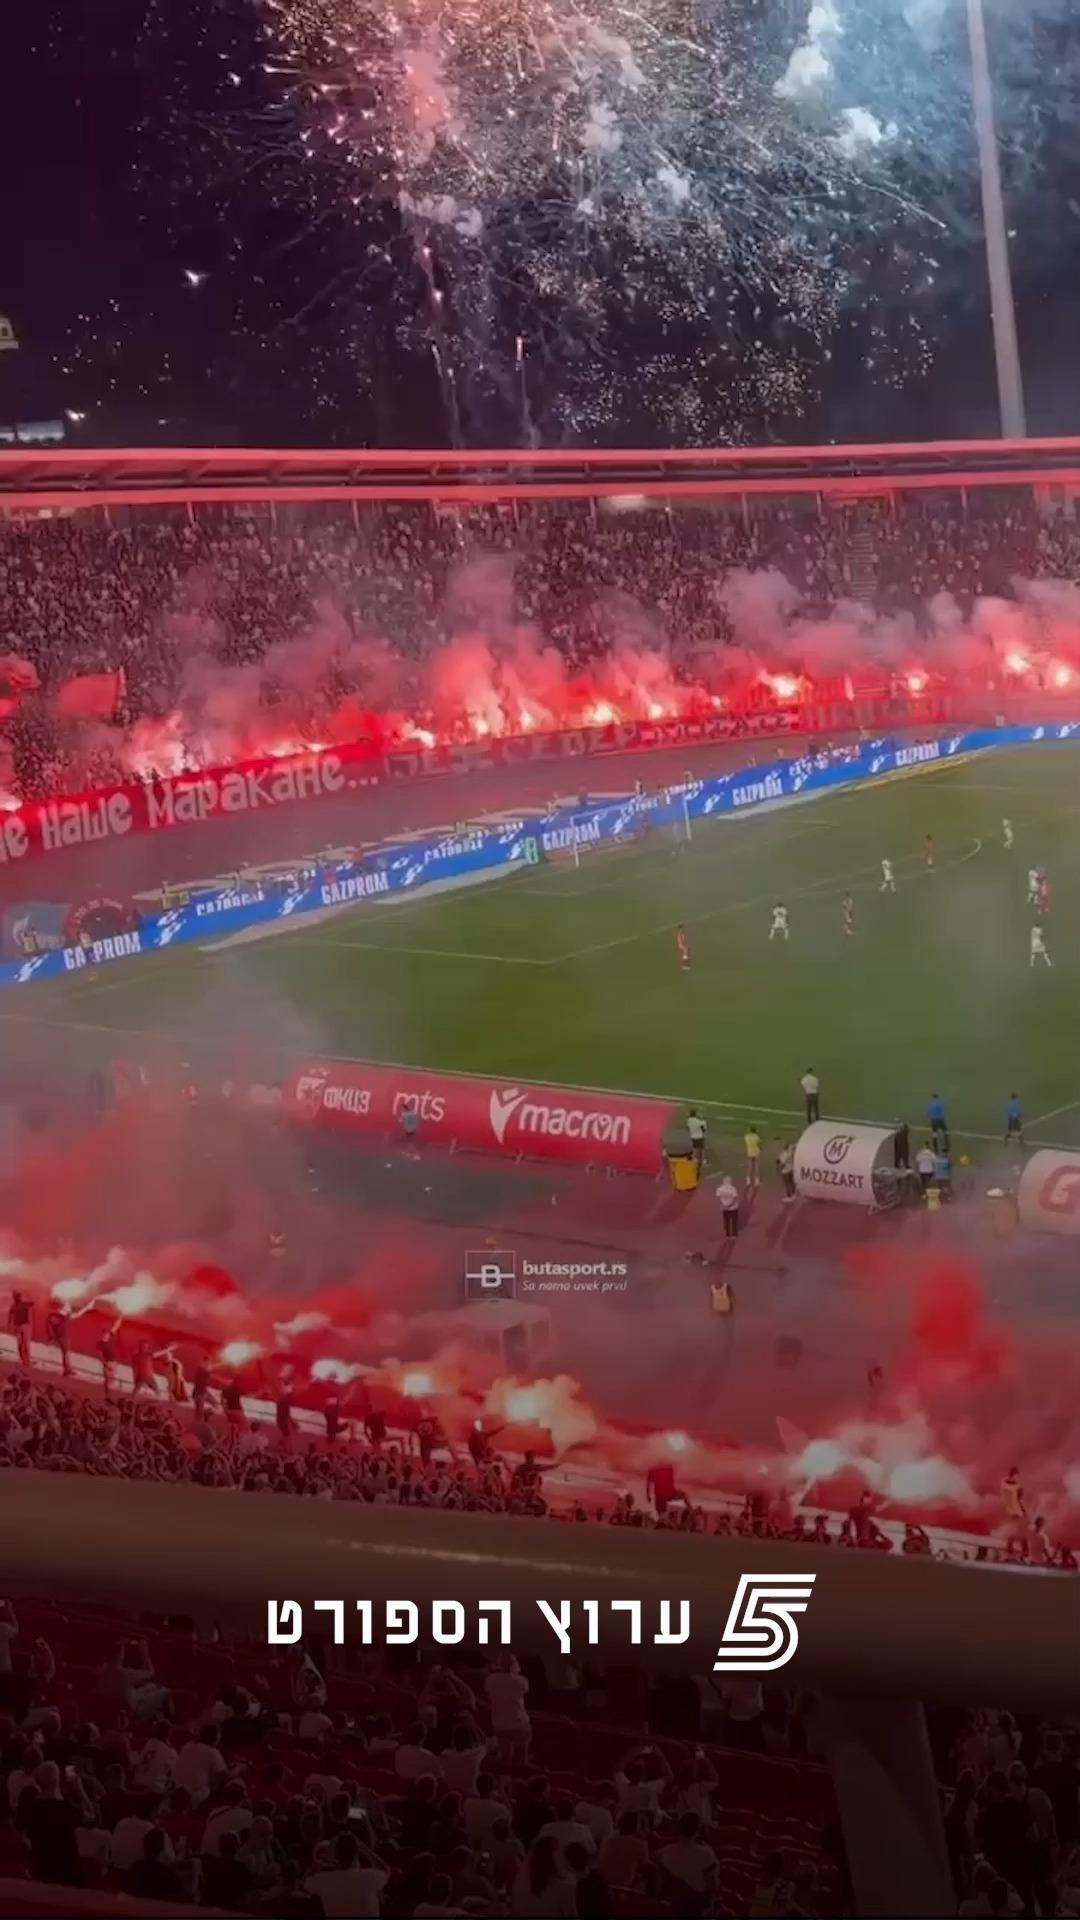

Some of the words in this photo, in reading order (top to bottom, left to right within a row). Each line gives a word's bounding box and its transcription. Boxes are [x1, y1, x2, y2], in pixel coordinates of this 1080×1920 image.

[320, 871, 389, 905] GAZPROM
[63, 931, 141, 970] GAPROM
[392, 1089, 446, 1122] mts
[518, 1103, 632, 1145] macron
[801, 1166, 864, 1189] MOZZART
